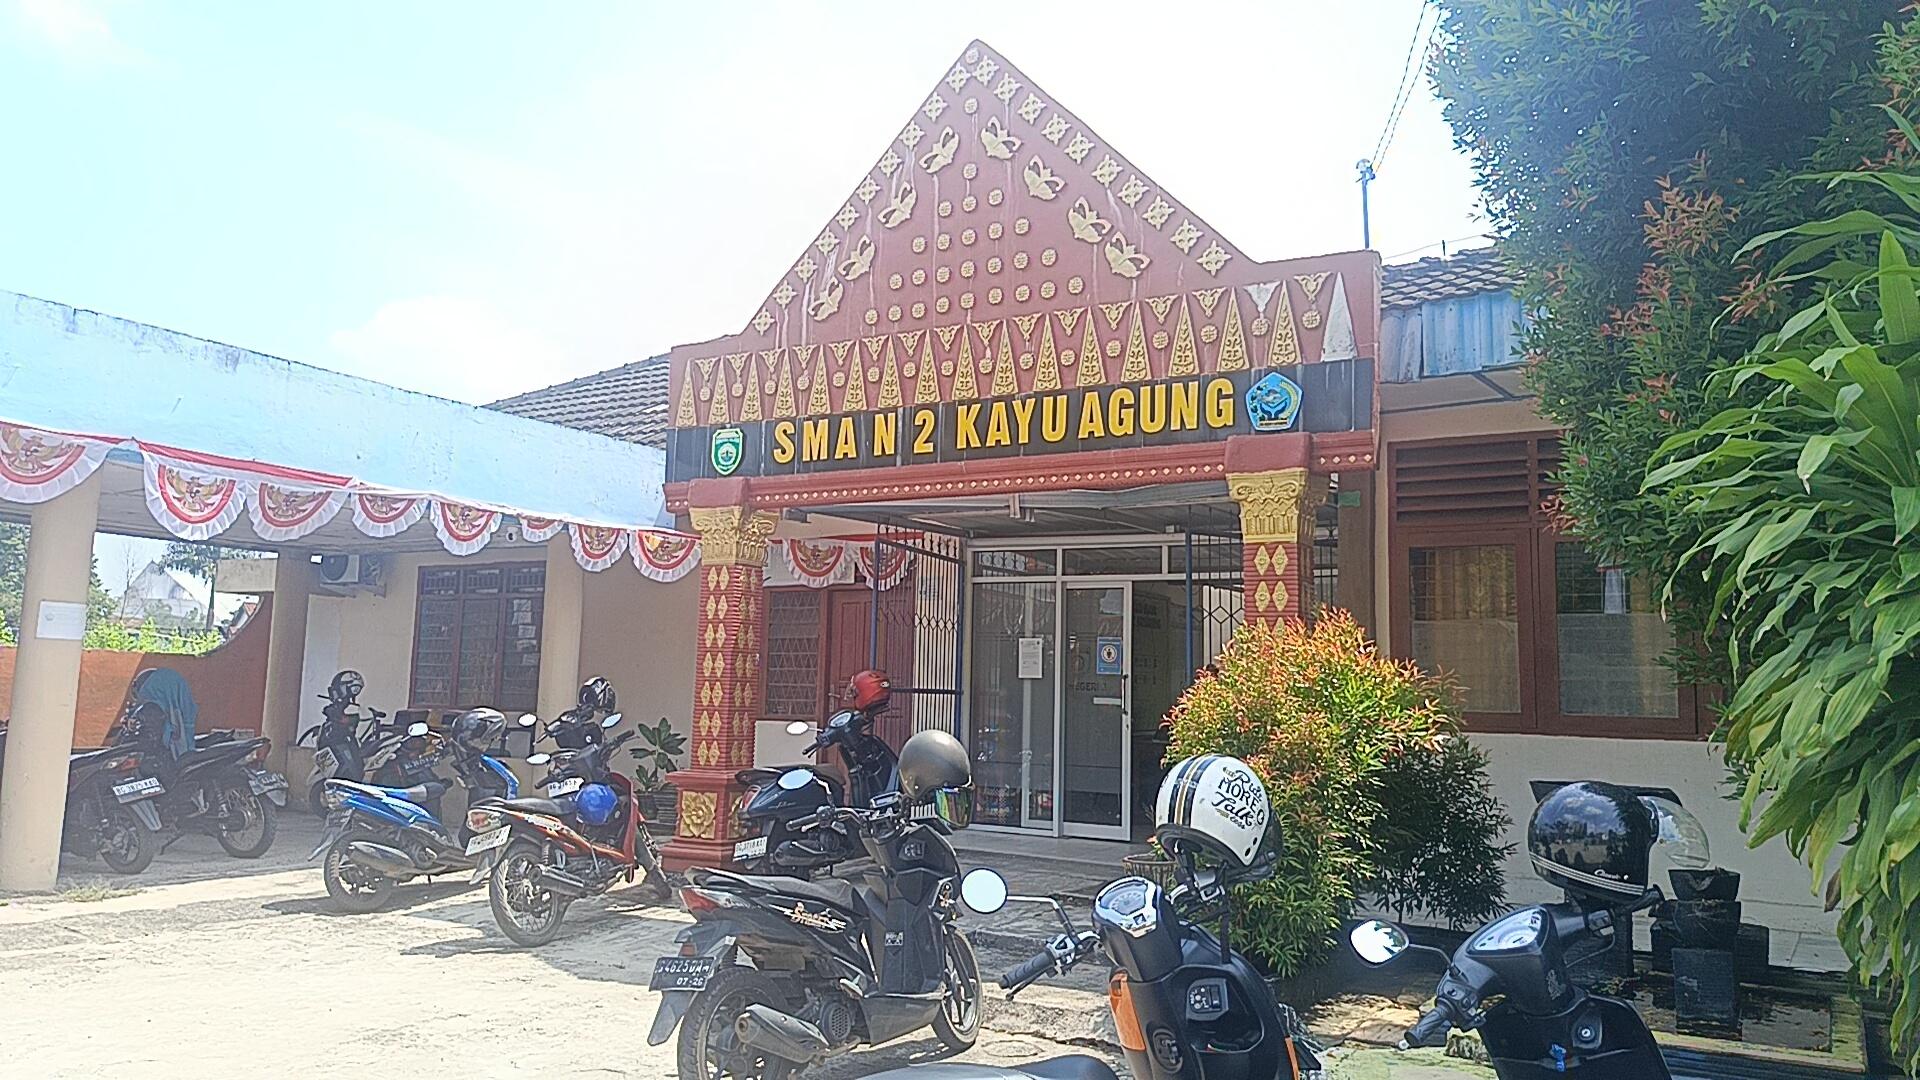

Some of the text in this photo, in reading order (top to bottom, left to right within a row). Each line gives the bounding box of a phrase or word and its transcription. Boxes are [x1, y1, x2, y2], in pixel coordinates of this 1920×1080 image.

[773, 416, 857, 464] SMA
[873, 412, 896, 457] N
[913, 409, 936, 454] 2
[1211, 791, 1254, 827] Talk
[1217, 776, 1259, 813] MORE
